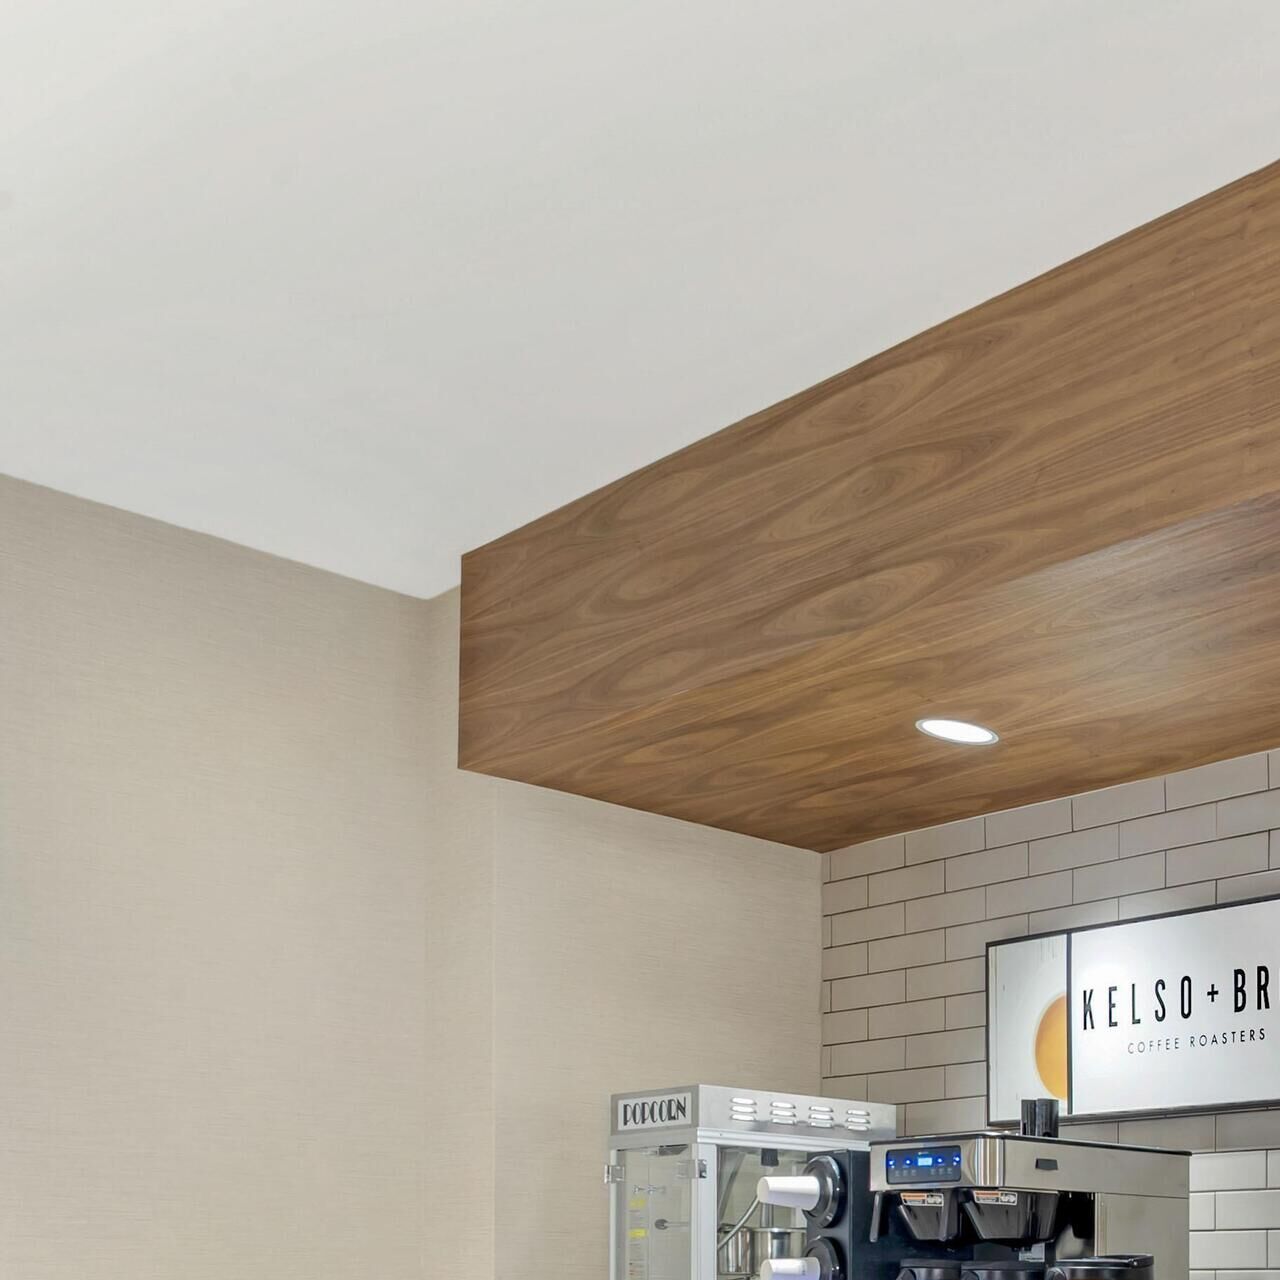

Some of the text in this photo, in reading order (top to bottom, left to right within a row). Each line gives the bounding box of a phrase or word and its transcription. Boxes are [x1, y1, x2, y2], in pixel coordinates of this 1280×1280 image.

[1083, 975, 1192, 1030] KELSO
[1128, 1028, 1266, 1054] COFFEE ROASTERS
[623, 1096, 686, 1126] POPCORN
